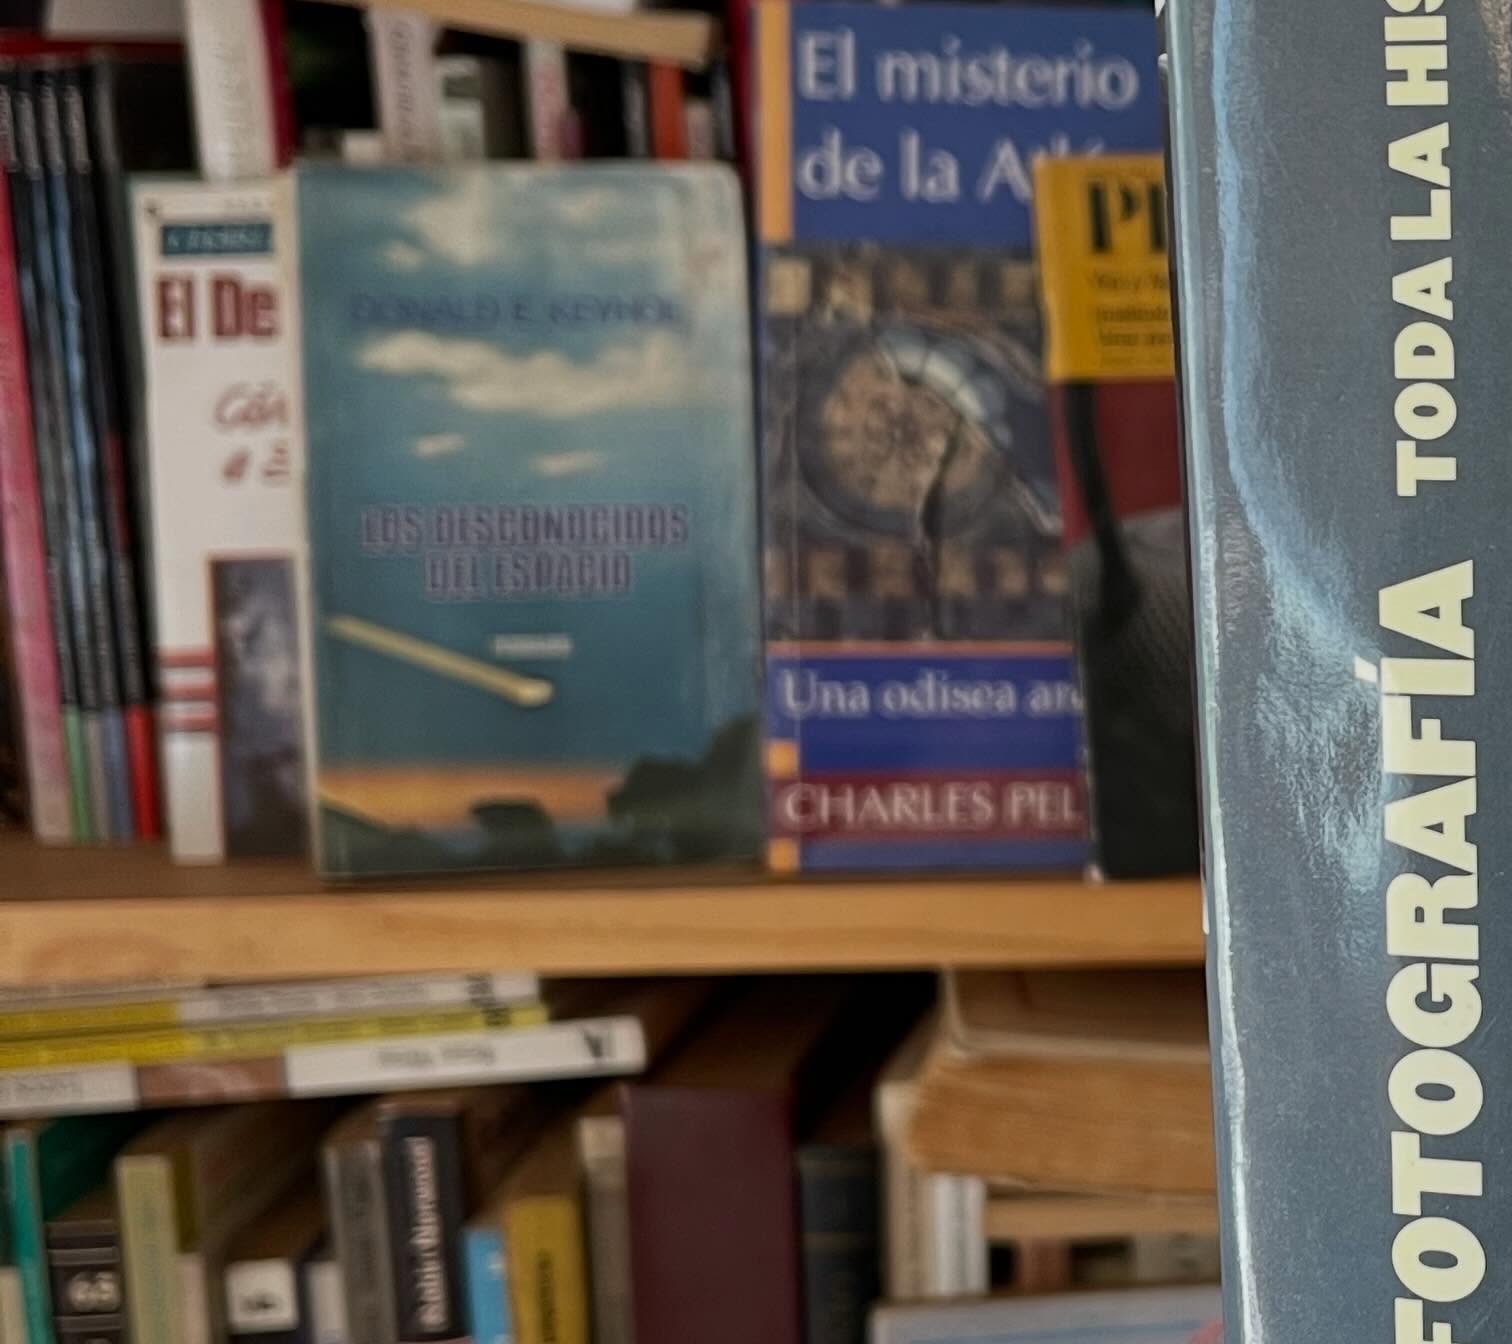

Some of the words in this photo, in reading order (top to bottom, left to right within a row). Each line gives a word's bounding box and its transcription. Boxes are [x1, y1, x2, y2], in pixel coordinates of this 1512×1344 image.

[800, 30, 857, 101] El
[878, 34, 1140, 109] misterio
[800, 129, 883, 201] de
[902, 130, 959, 203] la
[1388, 122, 1453, 241] LA
[1391, 256, 1457, 497] TODA
[362, 506, 424, 549] LOS
[434, 504, 691, 548] DESCONOCIDOS
[494, 551, 634, 597] ESPACIO
[780, 671, 871, 716] Una
[882, 668, 1018, 718] odisea
[784, 781, 993, 828] CHARLES
